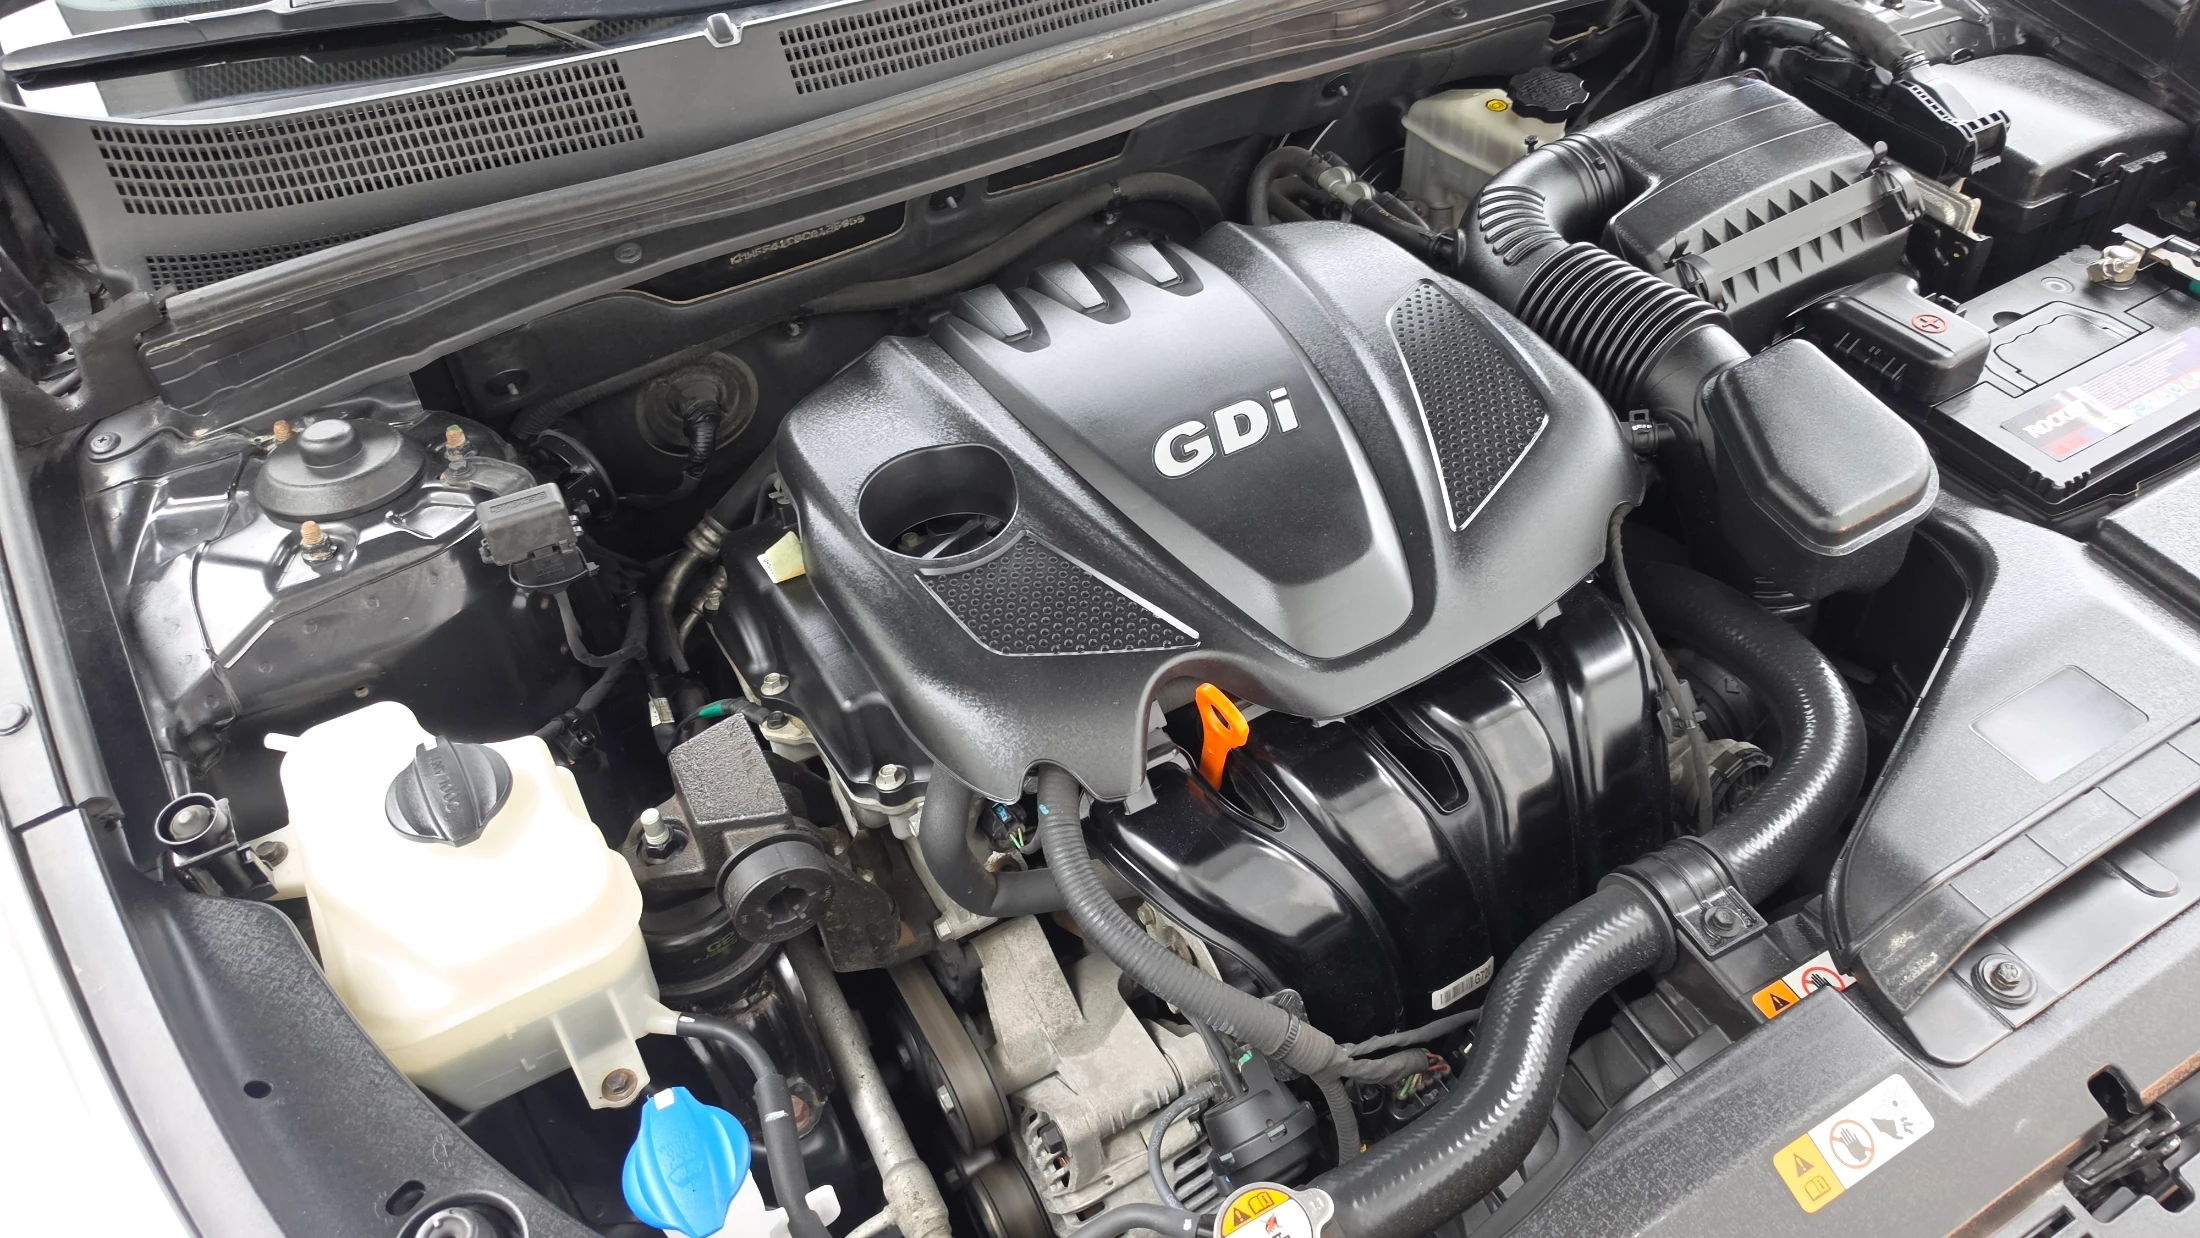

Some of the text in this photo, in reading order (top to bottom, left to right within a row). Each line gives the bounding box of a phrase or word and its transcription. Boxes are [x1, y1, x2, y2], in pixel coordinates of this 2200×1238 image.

[1151, 386, 1301, 478] GDi
[427, 754, 460, 814] COOLANT
[520, 1057, 537, 1073] L
